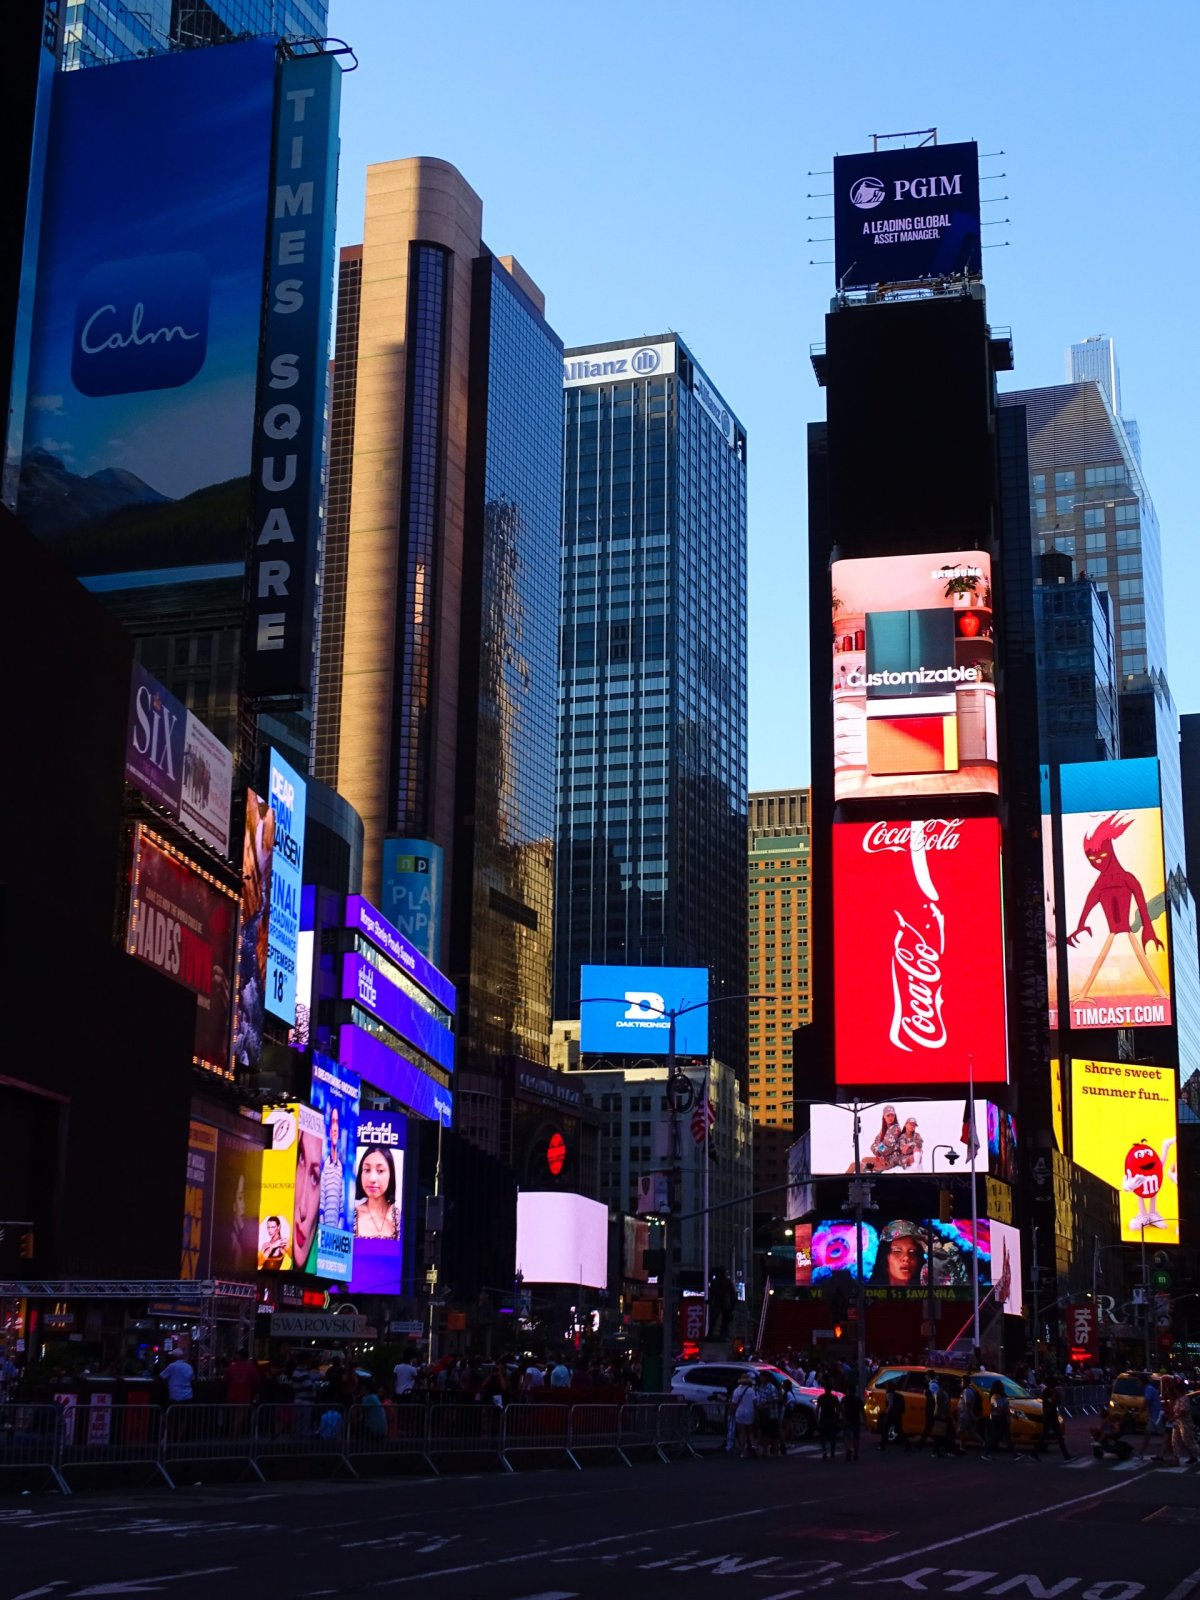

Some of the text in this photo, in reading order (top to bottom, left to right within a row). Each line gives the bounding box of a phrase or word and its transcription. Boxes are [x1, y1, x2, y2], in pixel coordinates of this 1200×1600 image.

[893, 174, 962, 201] PGIM
[863, 214, 951, 234] A LEADING GLOBAL
[874, 229, 940, 244] ASSET MANAGER.
[80, 303, 199, 354] Calm
[257, 88, 315, 650] TIMES SQUARE
[563, 359, 627, 381] Allianz
[931, 568, 982, 579] SAMSUNG
[847, 667, 977, 687] Customizable
[133, 686, 177, 781] SIX
[272, 767, 294, 812] DEAR
[862, 818, 965, 854] Coca-Cola
[267, 943, 295, 976] EPTEMBER
[1074, 1007, 1164, 1025] TIMCAST.COM
[1085, 1063, 1161, 1080] share sweet
[1082, 1086, 1169, 1102] summer fun...
[272, 1316, 357, 1333] SWAROVSKI
[1074, 1308, 1092, 1344] tkts
